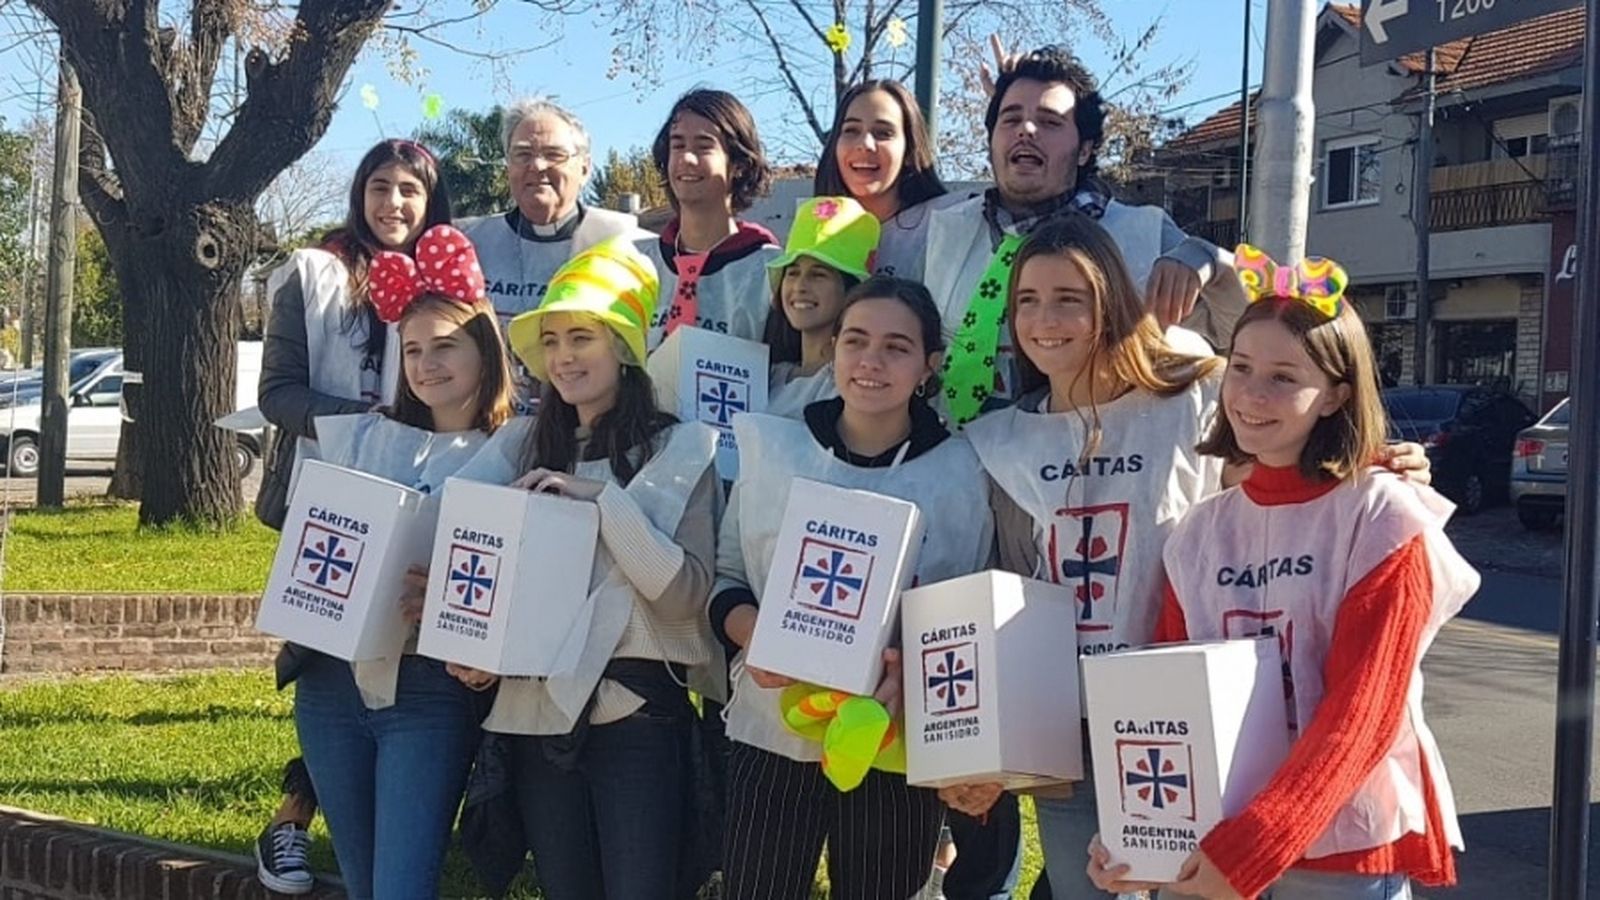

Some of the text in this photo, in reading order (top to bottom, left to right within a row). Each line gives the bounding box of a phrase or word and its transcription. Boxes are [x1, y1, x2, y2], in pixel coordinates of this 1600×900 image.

[805, 519, 878, 548] CÁRITAS
[284, 585, 345, 613] ARGENTINA
[439, 610, 489, 631] ARGENTINA
[784, 609, 856, 635] ARGENTINA
[924, 716, 979, 733] ARGENTINA
[1122, 824, 1198, 840] ARGENTINA
